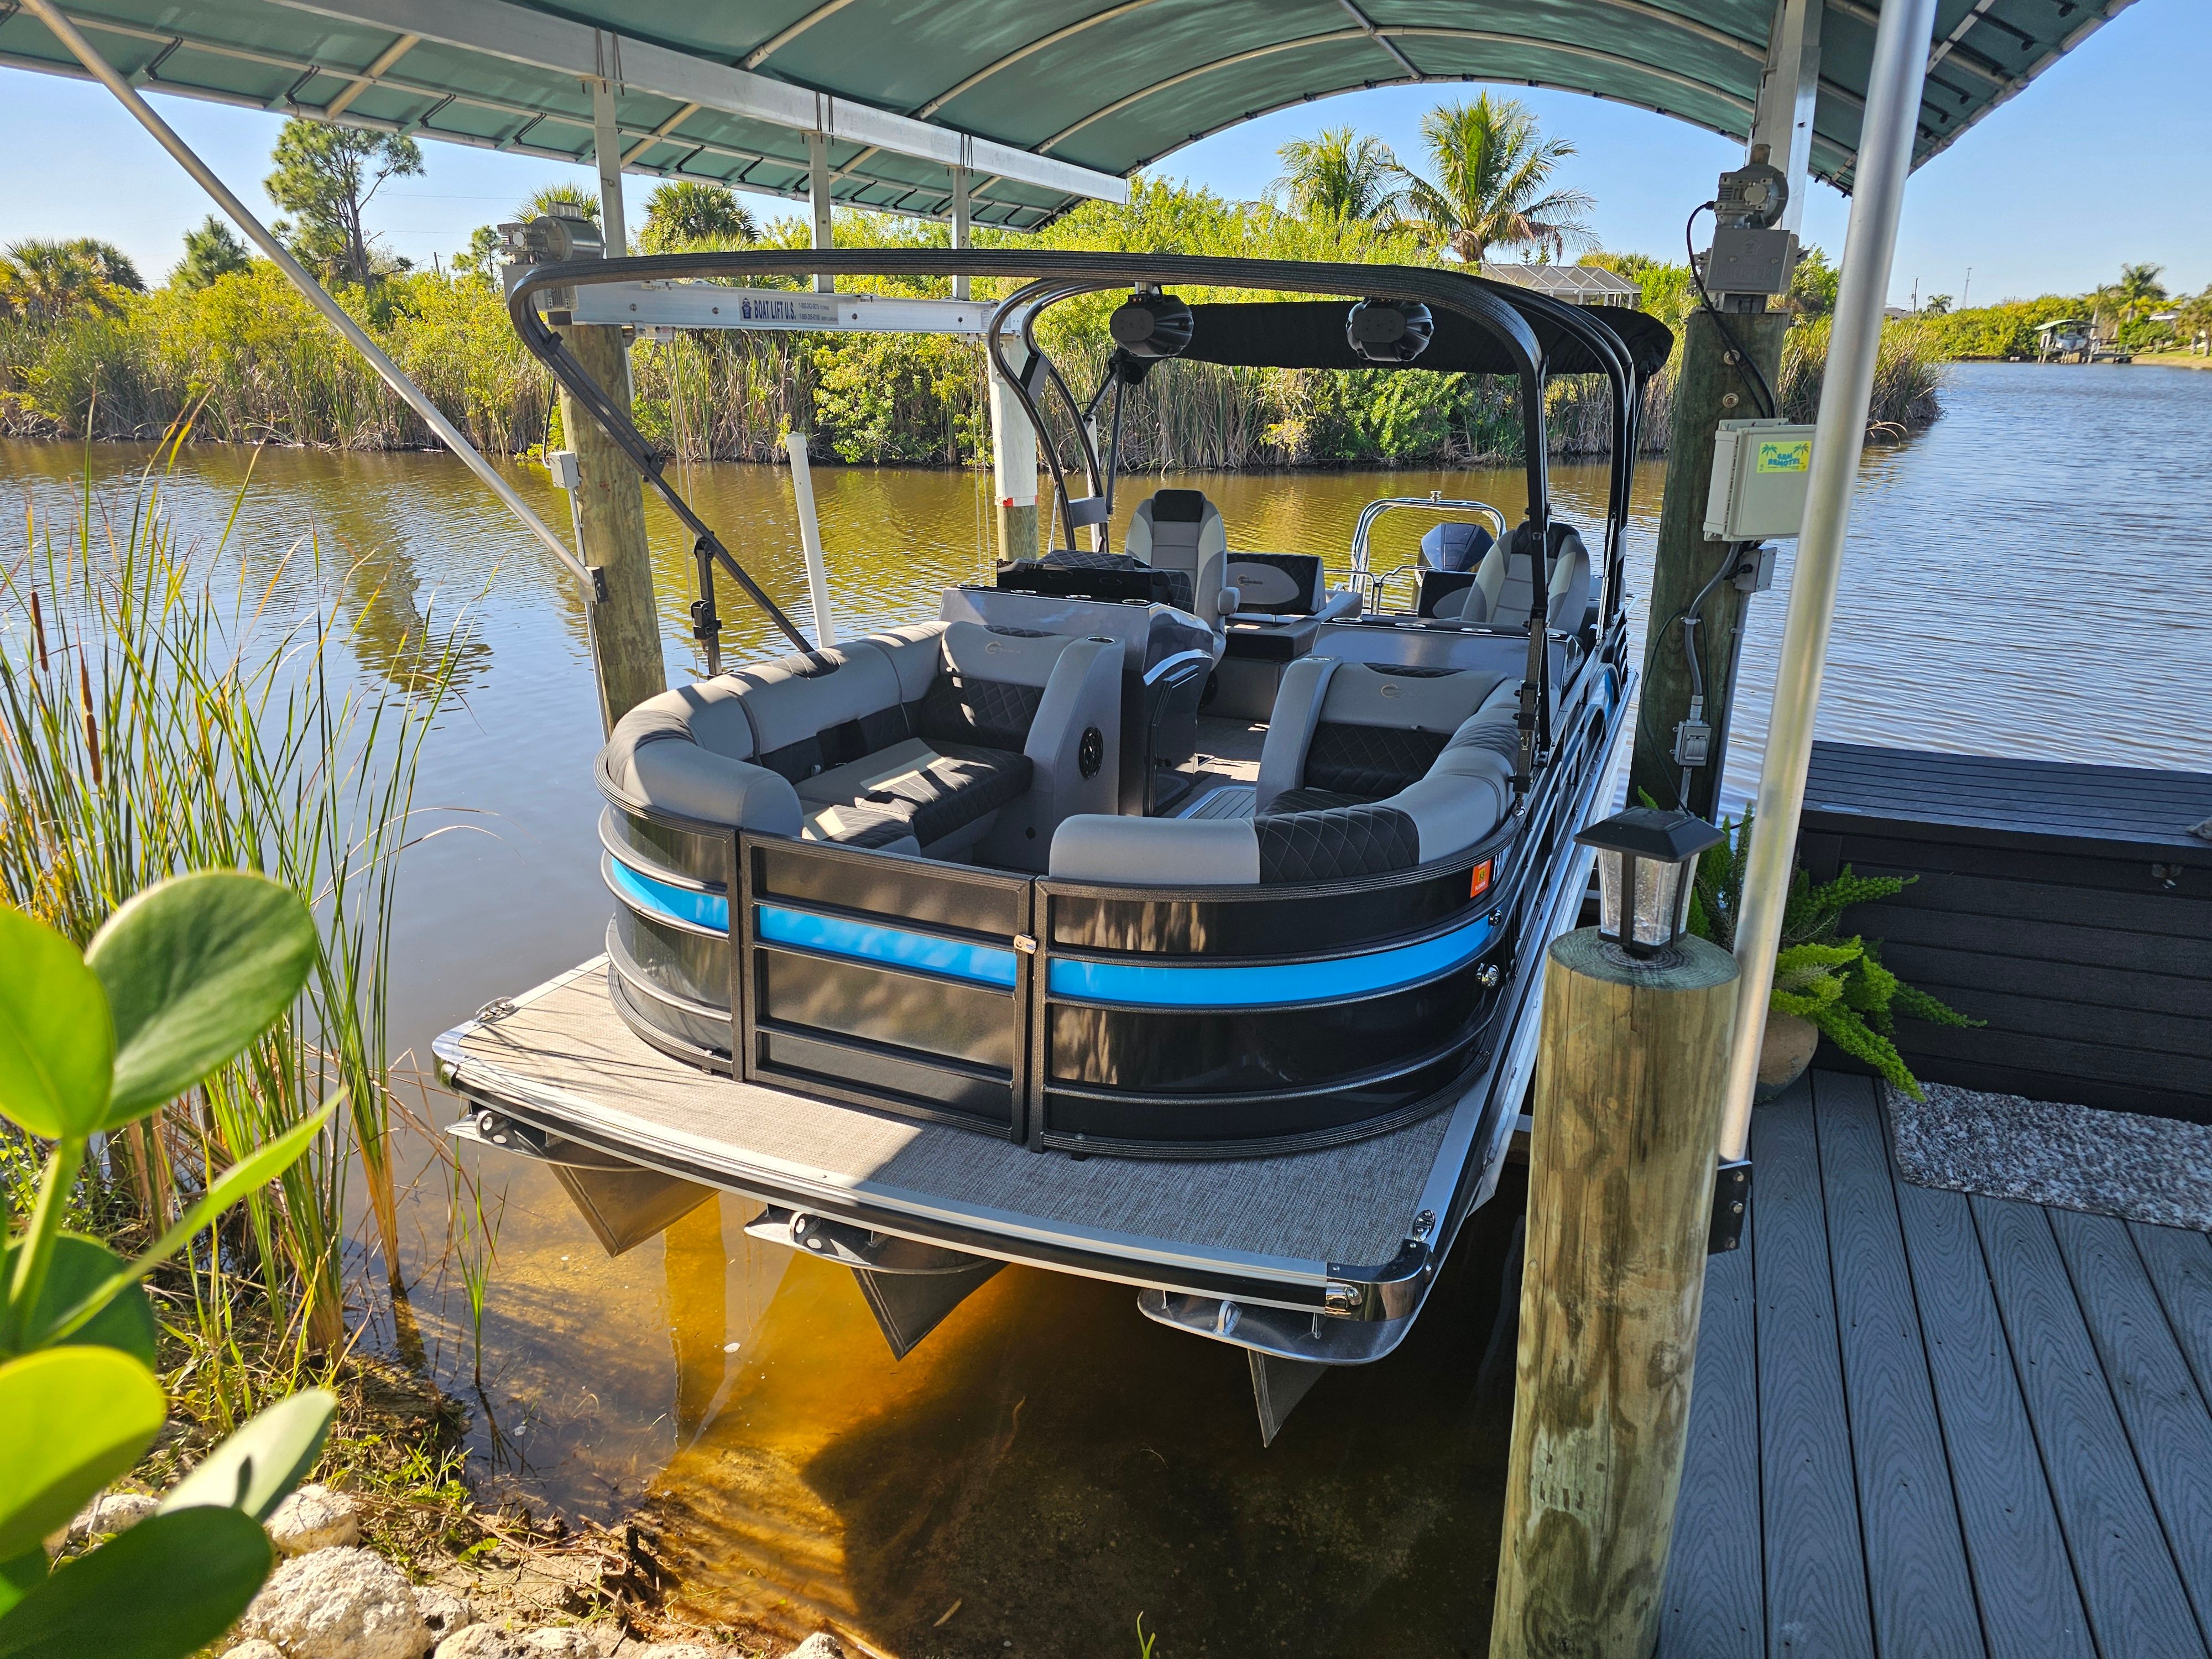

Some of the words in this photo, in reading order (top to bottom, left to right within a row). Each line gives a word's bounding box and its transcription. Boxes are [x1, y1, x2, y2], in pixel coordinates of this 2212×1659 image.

[754, 300, 769, 319] BOAT
[770, 300, 783, 319] LIFT
[784, 301, 796, 320] U.S.
